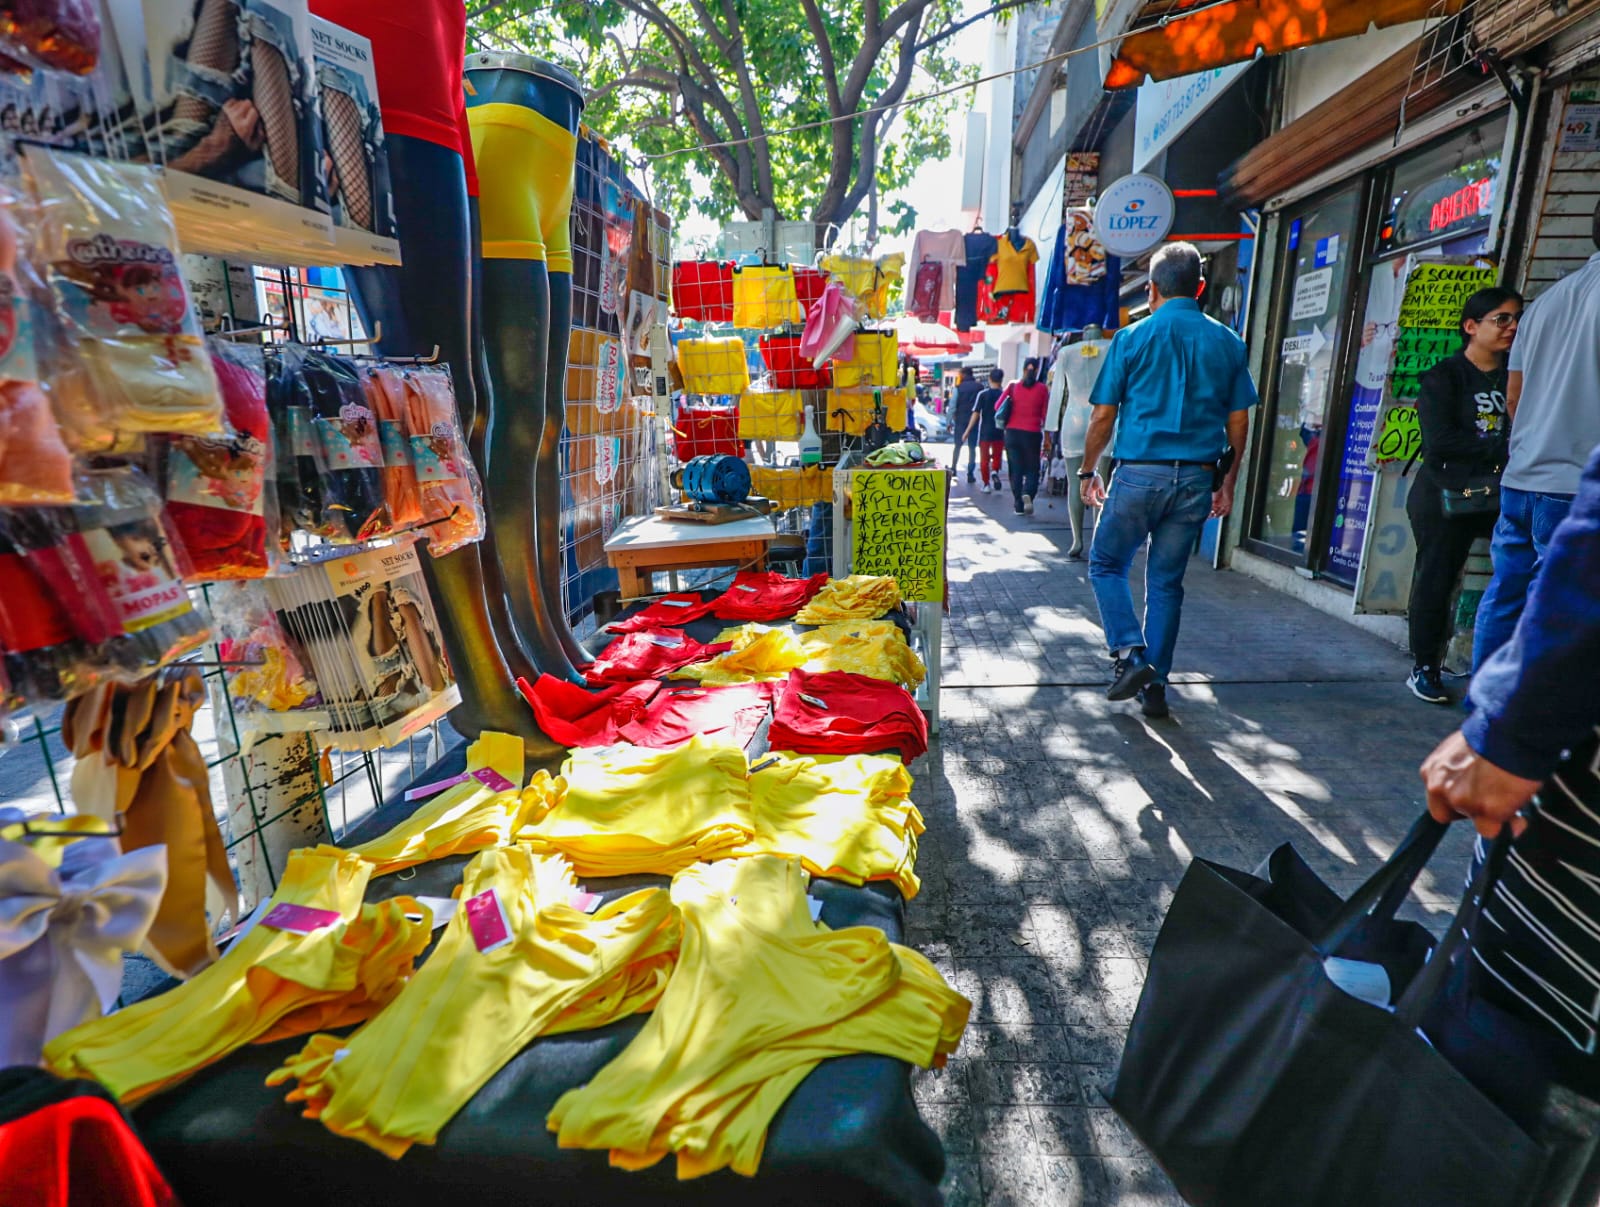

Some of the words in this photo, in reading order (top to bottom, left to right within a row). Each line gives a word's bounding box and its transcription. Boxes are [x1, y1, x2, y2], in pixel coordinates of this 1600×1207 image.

[310, 27, 333, 46] NET
[334, 38, 369, 63] SOCKS
[1428, 177, 1490, 233] ABIERTO
[1427, 267, 1495, 283] SOLICITA
[855, 473, 881, 493] SE
[884, 473, 936, 492] PONEN
[872, 510, 939, 528] PERNOS
[380, 556, 394, 567] NET
[394, 551, 415, 562] SOCKS
[855, 557, 892, 569] PARA
[898, 555, 938, 567] RELOJ
[122, 586, 179, 615] MOPAS
